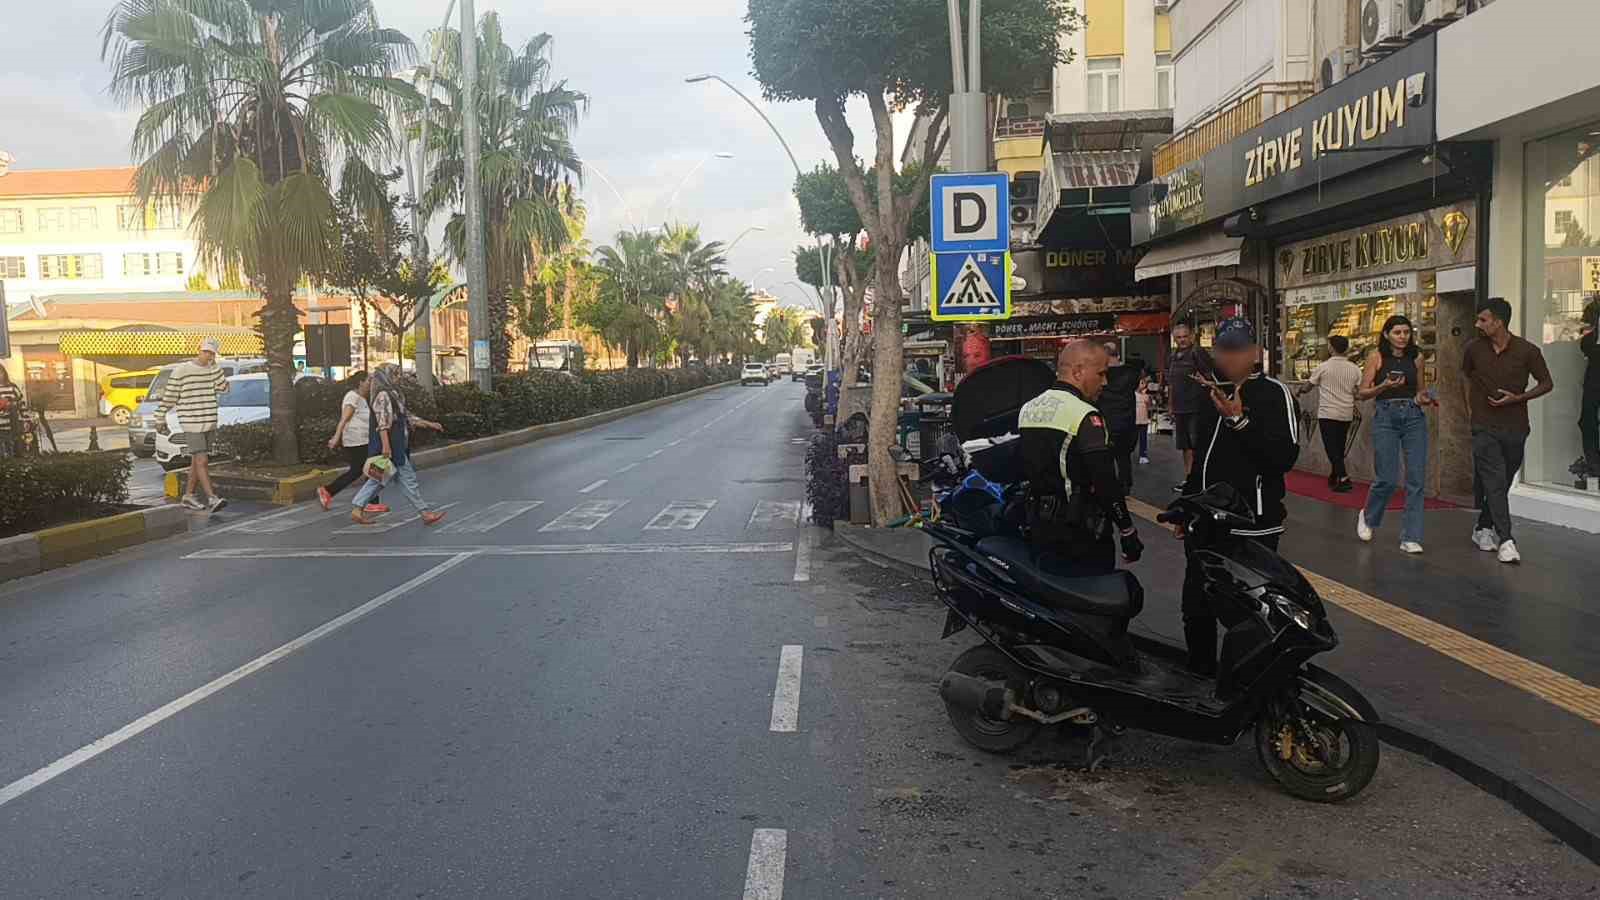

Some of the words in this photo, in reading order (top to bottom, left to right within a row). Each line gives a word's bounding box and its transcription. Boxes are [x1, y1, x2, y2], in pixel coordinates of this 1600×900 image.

[1243, 126, 1303, 187] ZİRVE
[1311, 78, 1408, 160] KUYUM
[953, 192, 987, 234] D
[1046, 248, 1106, 268] DÖNER
[1301, 240, 1352, 276] ZİRVE
[1355, 222, 1429, 270] KUYUM
[1372, 277, 1408, 293] MAĞAZASI
